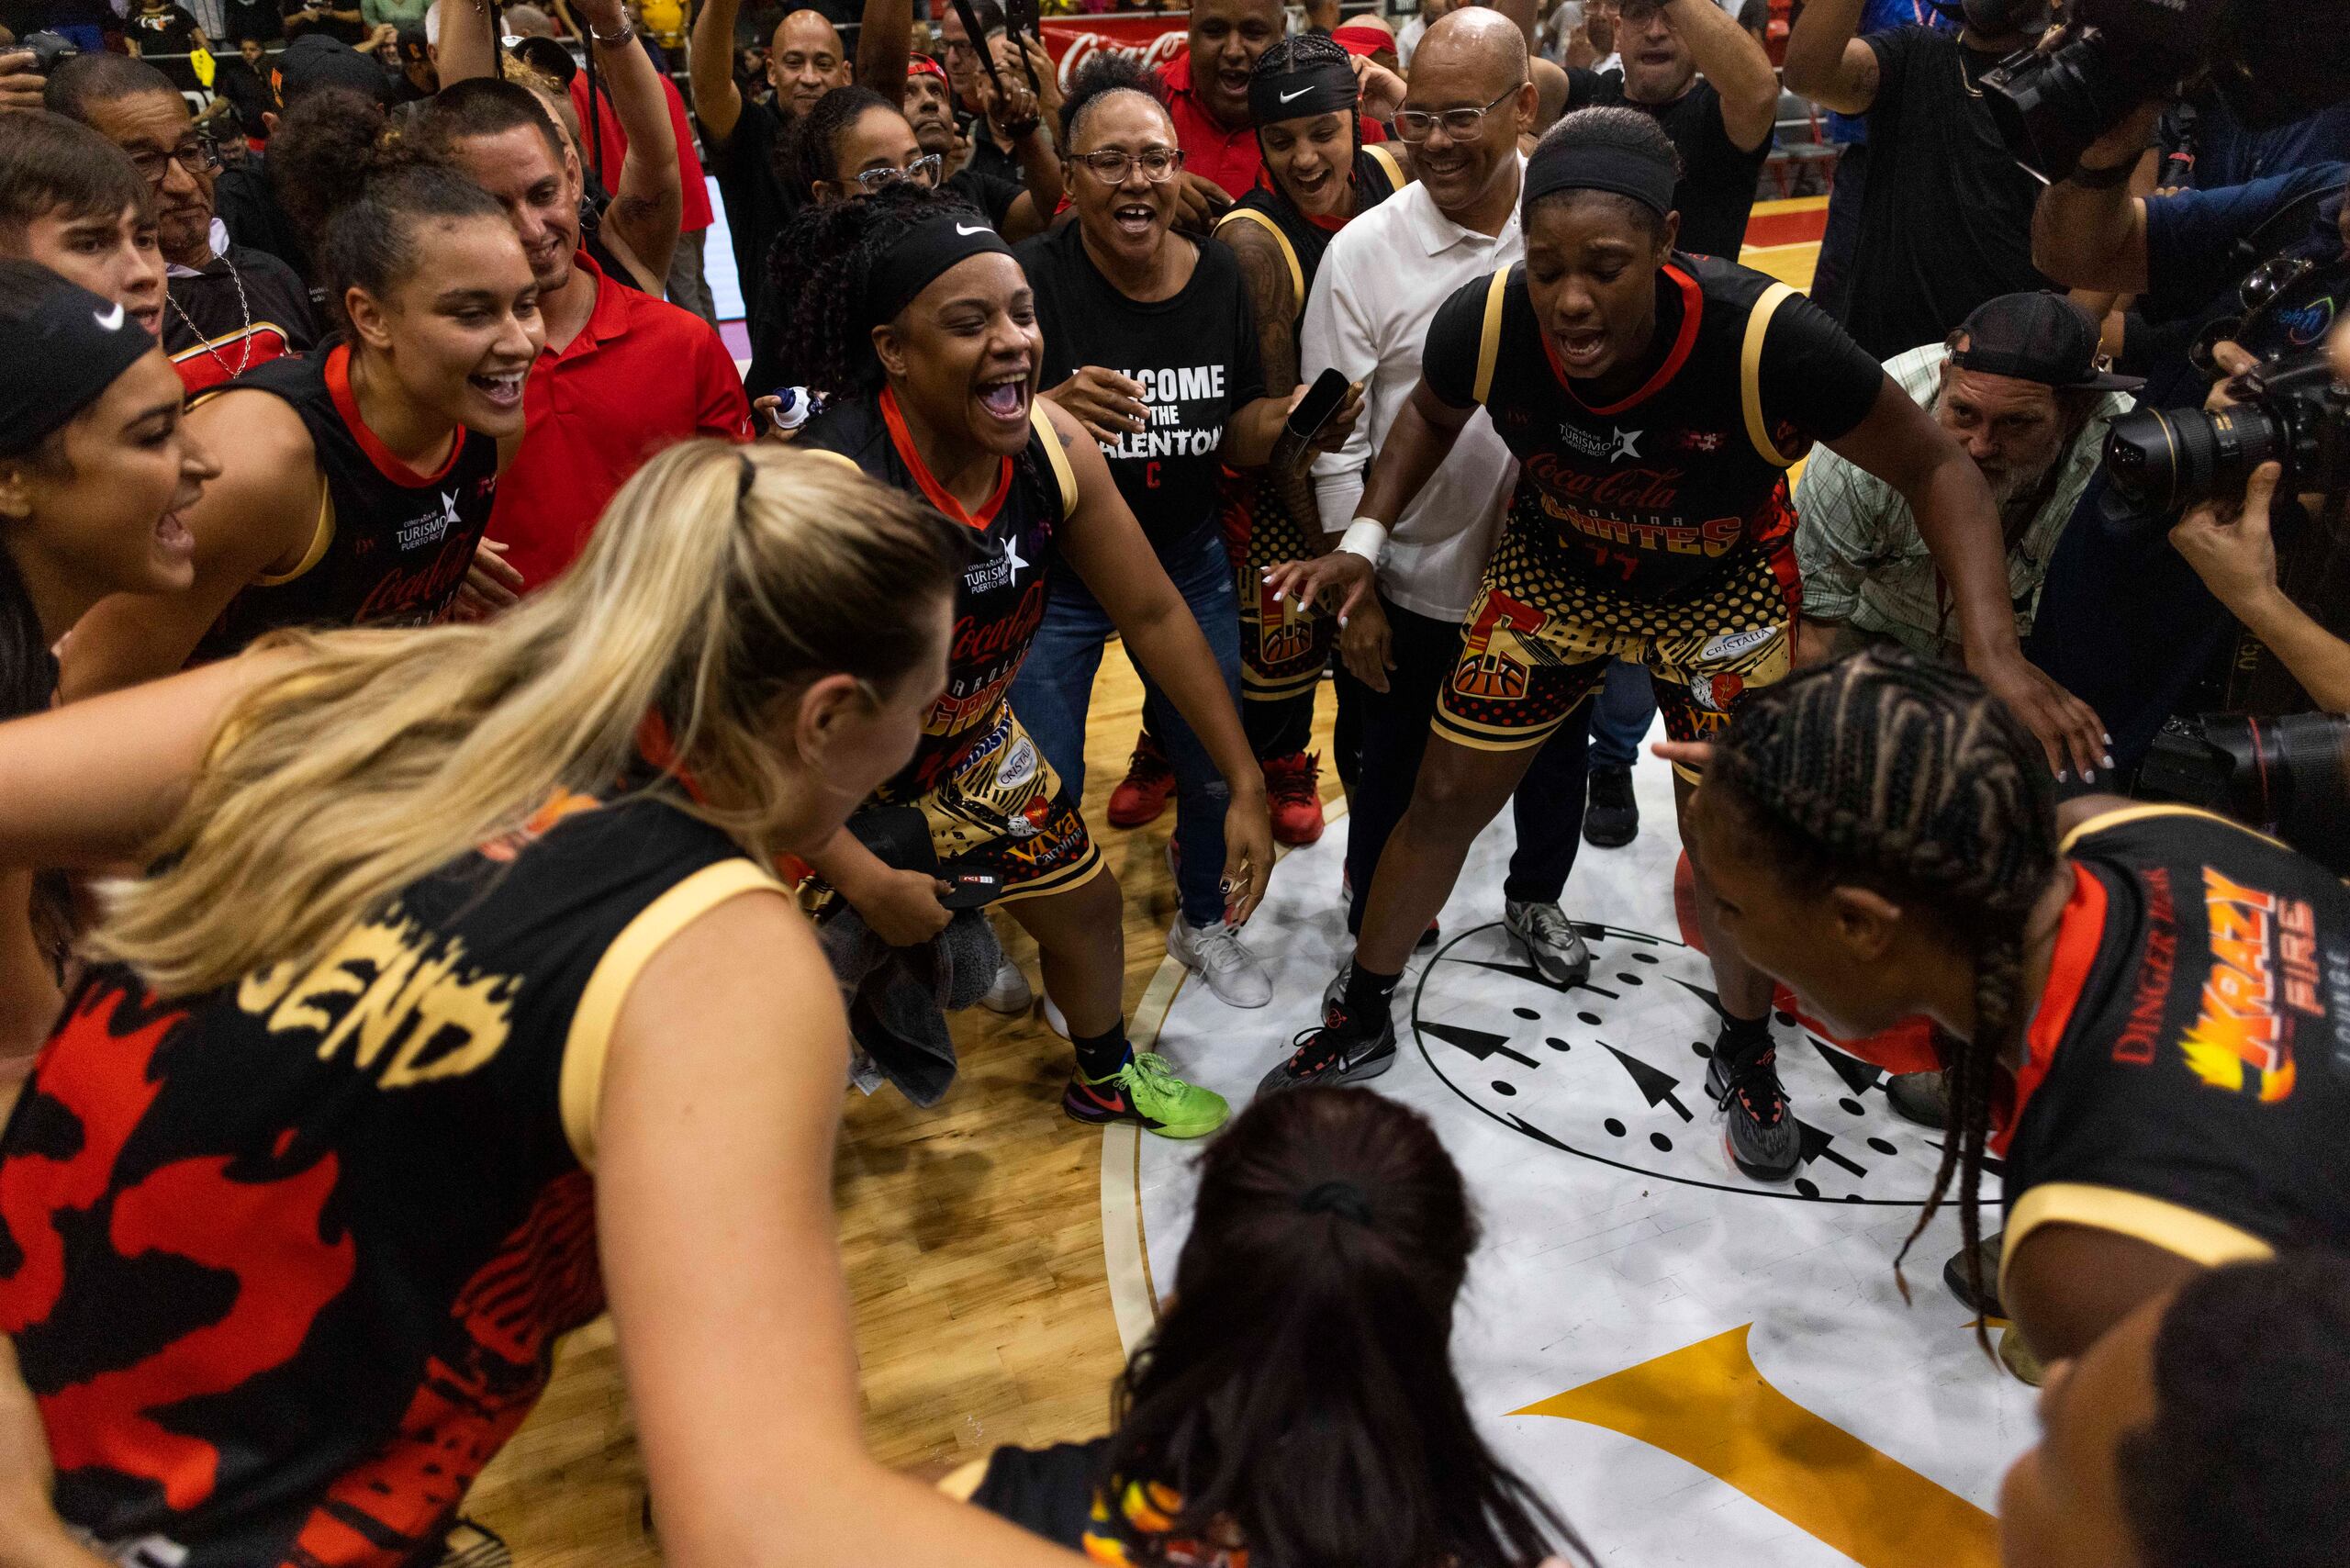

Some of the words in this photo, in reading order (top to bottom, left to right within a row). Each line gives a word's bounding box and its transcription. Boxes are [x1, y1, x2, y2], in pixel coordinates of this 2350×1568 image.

[1148, 405, 1181, 426] THE
[1560, 423, 1612, 452] TURISMO
[1561, 436, 1587, 454] PUERTO
[1587, 449, 1606, 457] RICO
[396, 515, 448, 543] TURISMO
[401, 534, 429, 551] PUERTO
[971, 581, 998, 595] PUERTO
[1706, 627, 1772, 656] CRISTALIA
[1000, 742, 1032, 785] CRISTALIA
[2196, 865, 2282, 1074] KRAZY
[2277, 896, 2326, 1018] FIRE
